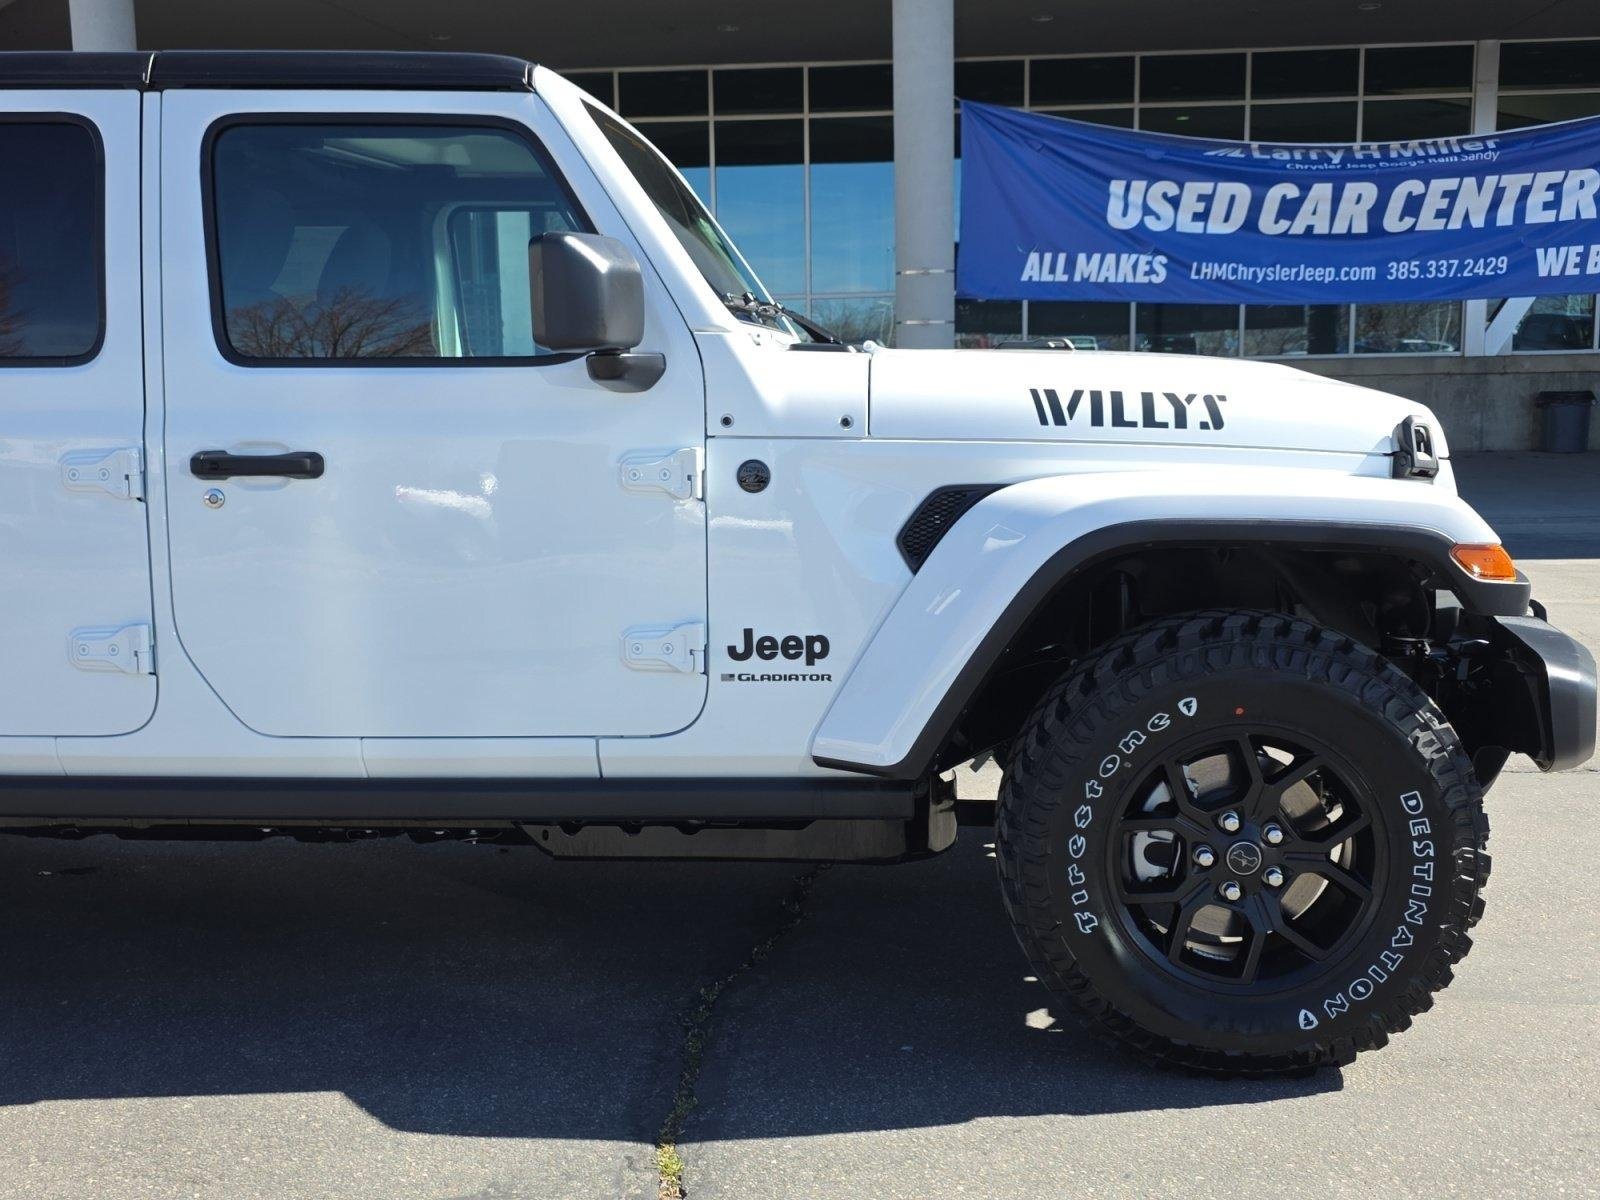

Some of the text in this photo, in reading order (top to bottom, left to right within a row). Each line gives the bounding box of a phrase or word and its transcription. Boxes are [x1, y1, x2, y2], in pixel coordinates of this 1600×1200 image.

[1251, 144, 1345, 164] Larry
[1389, 138, 1501, 158] Miller
[1286, 162, 1342, 170] Chrysler
[1106, 168, 1600, 236] USED CAR CENTER
[1021, 252, 1169, 284] ALL MAKES
[1190, 255, 1508, 284] LHMChryslerJeep.com 385.337.2429
[1536, 245, 1584, 277] WE
[1029, 388, 1227, 430] WILLYS
[727, 628, 830, 666] Jeep
[737, 673, 833, 682] GLADIATOR
[1323, 790, 1434, 1019] DESTINATION
